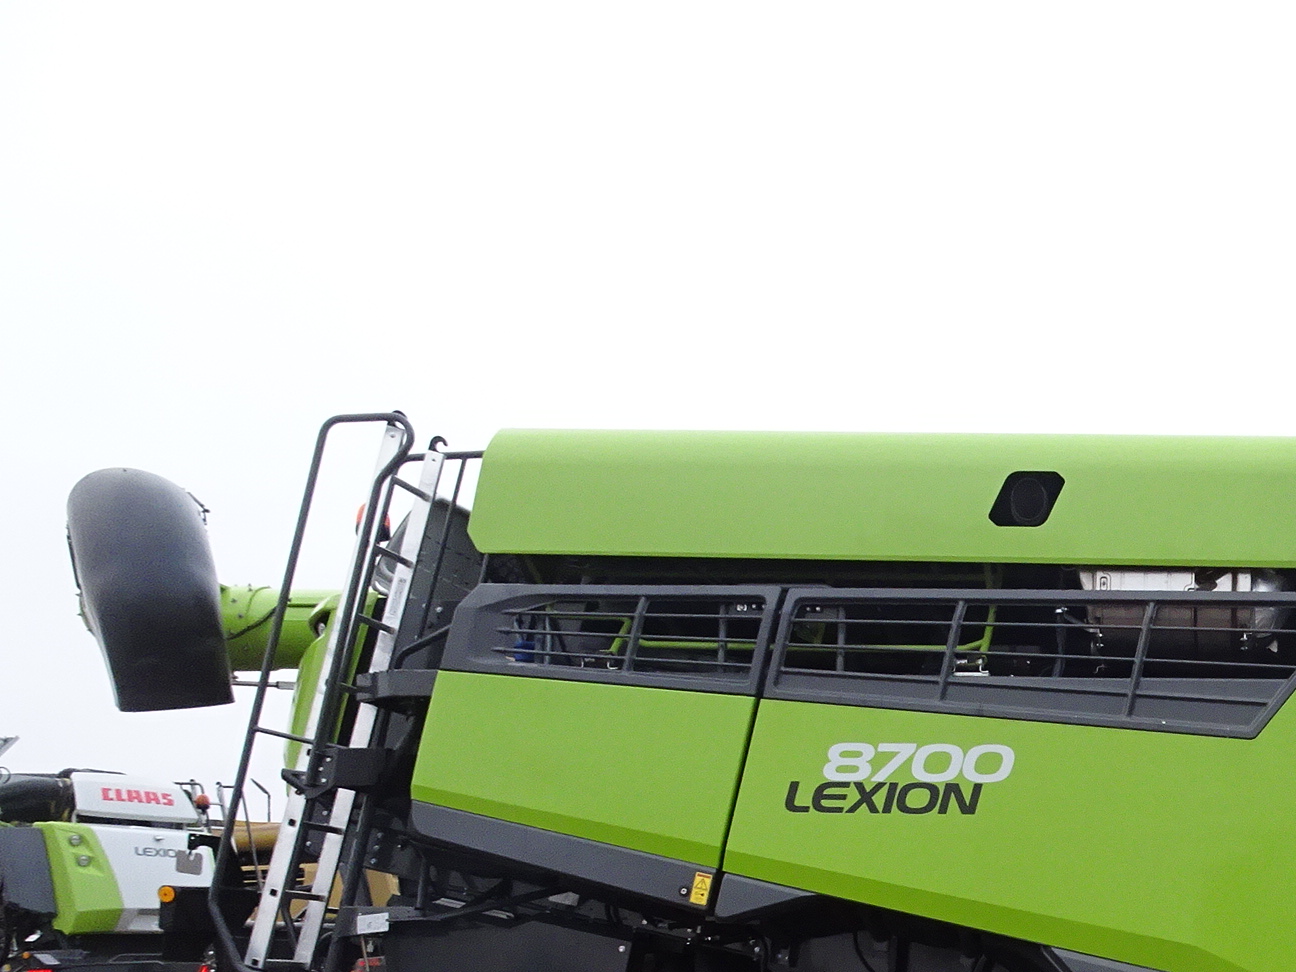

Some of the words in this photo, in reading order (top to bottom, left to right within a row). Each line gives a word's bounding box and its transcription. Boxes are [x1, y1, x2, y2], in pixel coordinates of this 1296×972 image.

[822, 742, 1016, 783] 8700
[101, 787, 175, 806] CLAAS
[785, 781, 984, 815] LEXION
[134, 846, 178, 859] LEXIO
